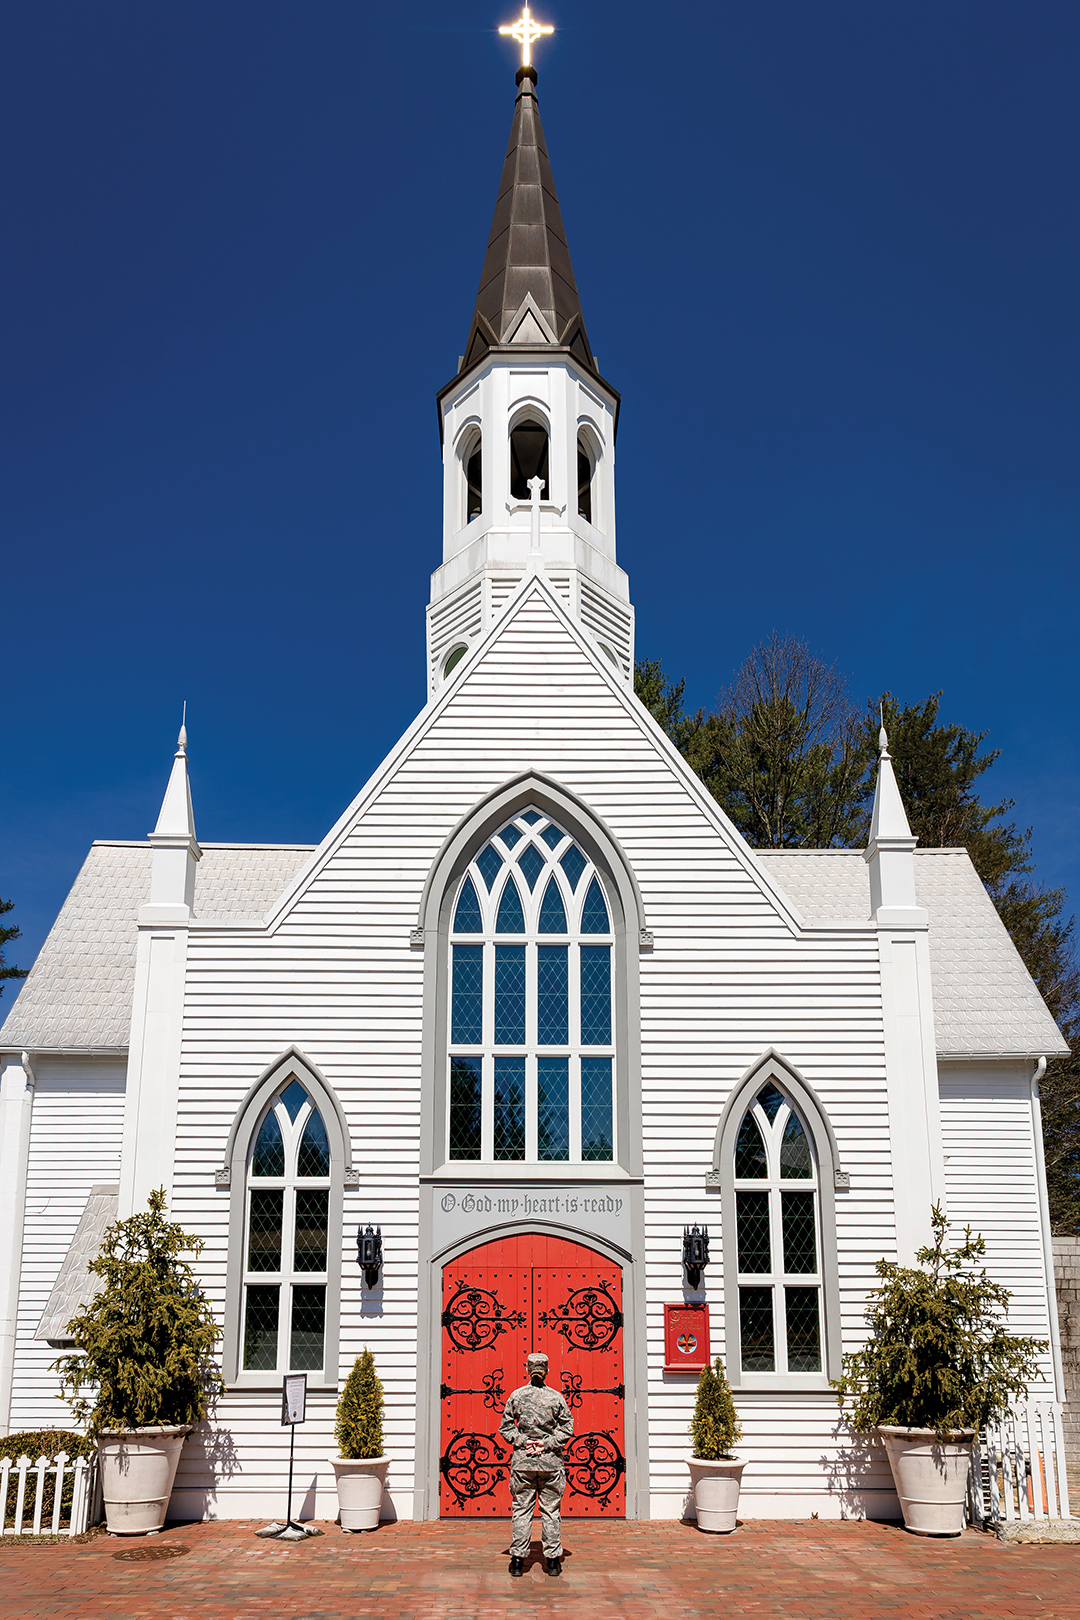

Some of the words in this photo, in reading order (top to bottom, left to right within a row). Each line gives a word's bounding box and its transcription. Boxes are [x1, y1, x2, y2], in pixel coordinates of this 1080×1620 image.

[461, 1192, 492, 1213] God
[497, 1197, 519, 1217] my
[523, 1194, 560, 1217] heart
[565, 1194, 579, 1213] is
[583, 1194, 623, 1217] ready
